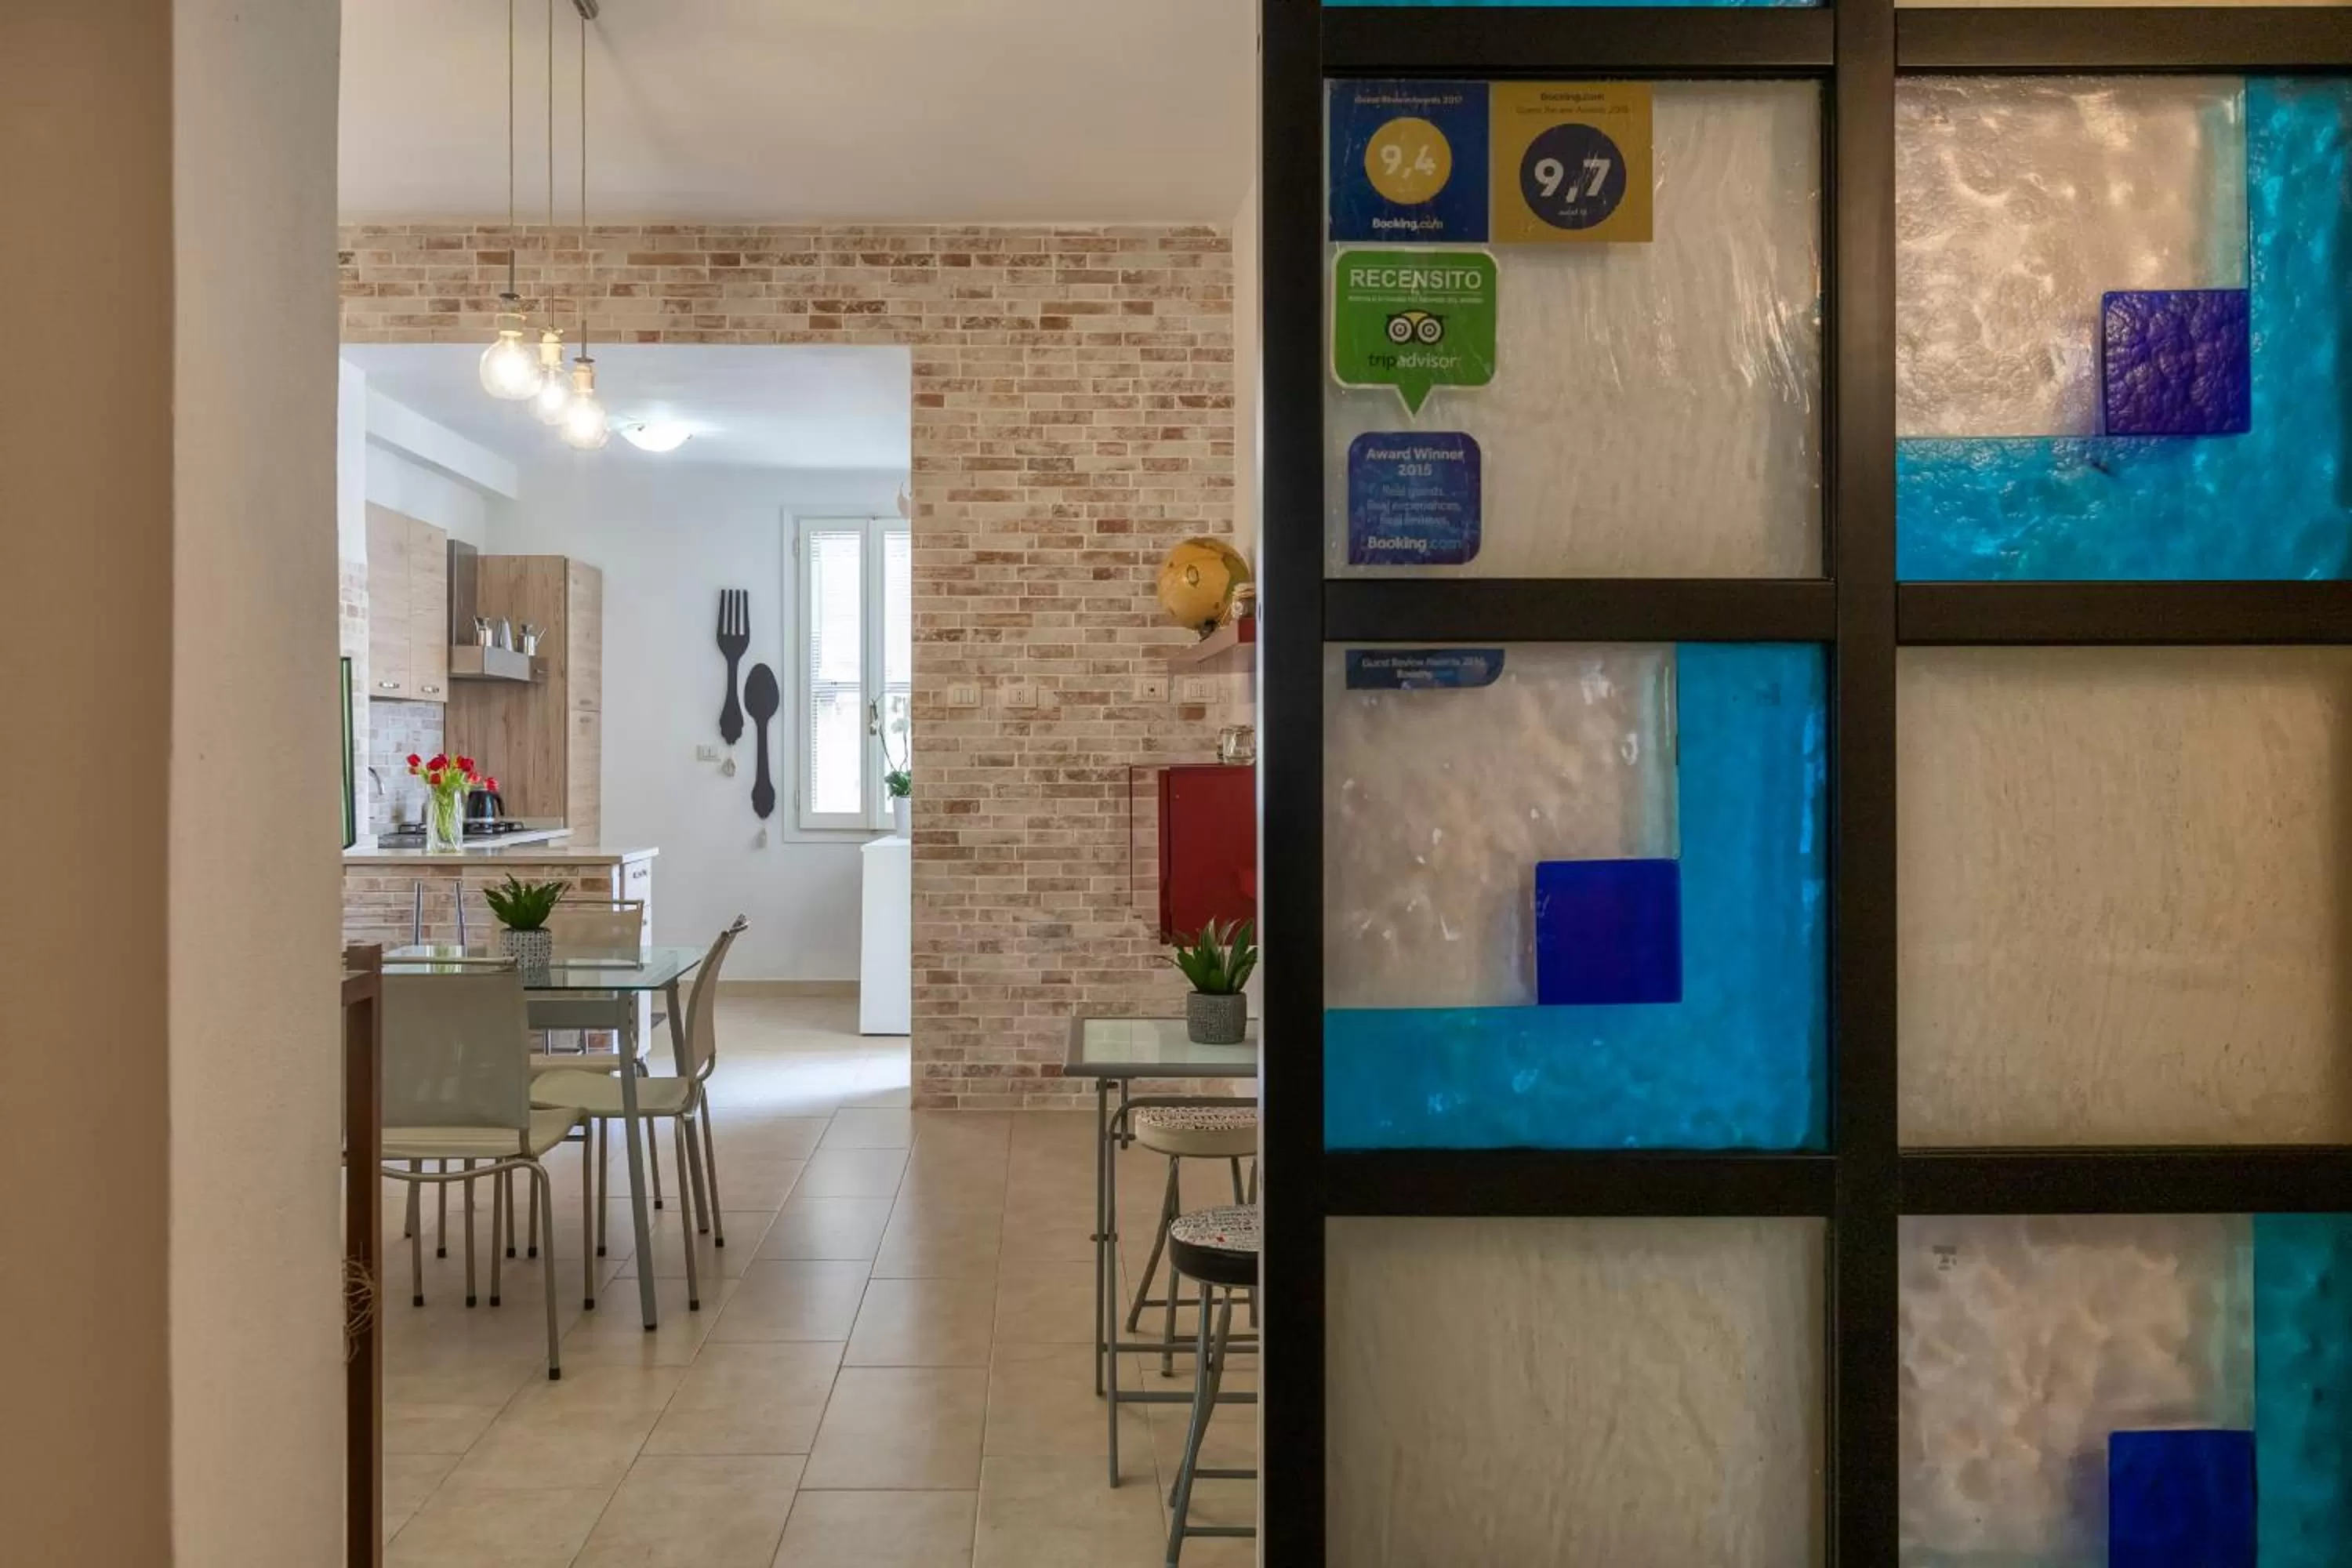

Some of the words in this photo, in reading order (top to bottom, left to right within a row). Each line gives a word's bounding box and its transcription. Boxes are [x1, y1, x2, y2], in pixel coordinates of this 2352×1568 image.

[1534, 157, 1611, 204] 9,7
[1349, 269, 1482, 289] RECENSITO
[1367, 353, 1457, 371] tripadvisor
[1367, 447, 1410, 460] Award
[1414, 448, 1465, 460] Winner
[1398, 463, 1432, 477] 2015
